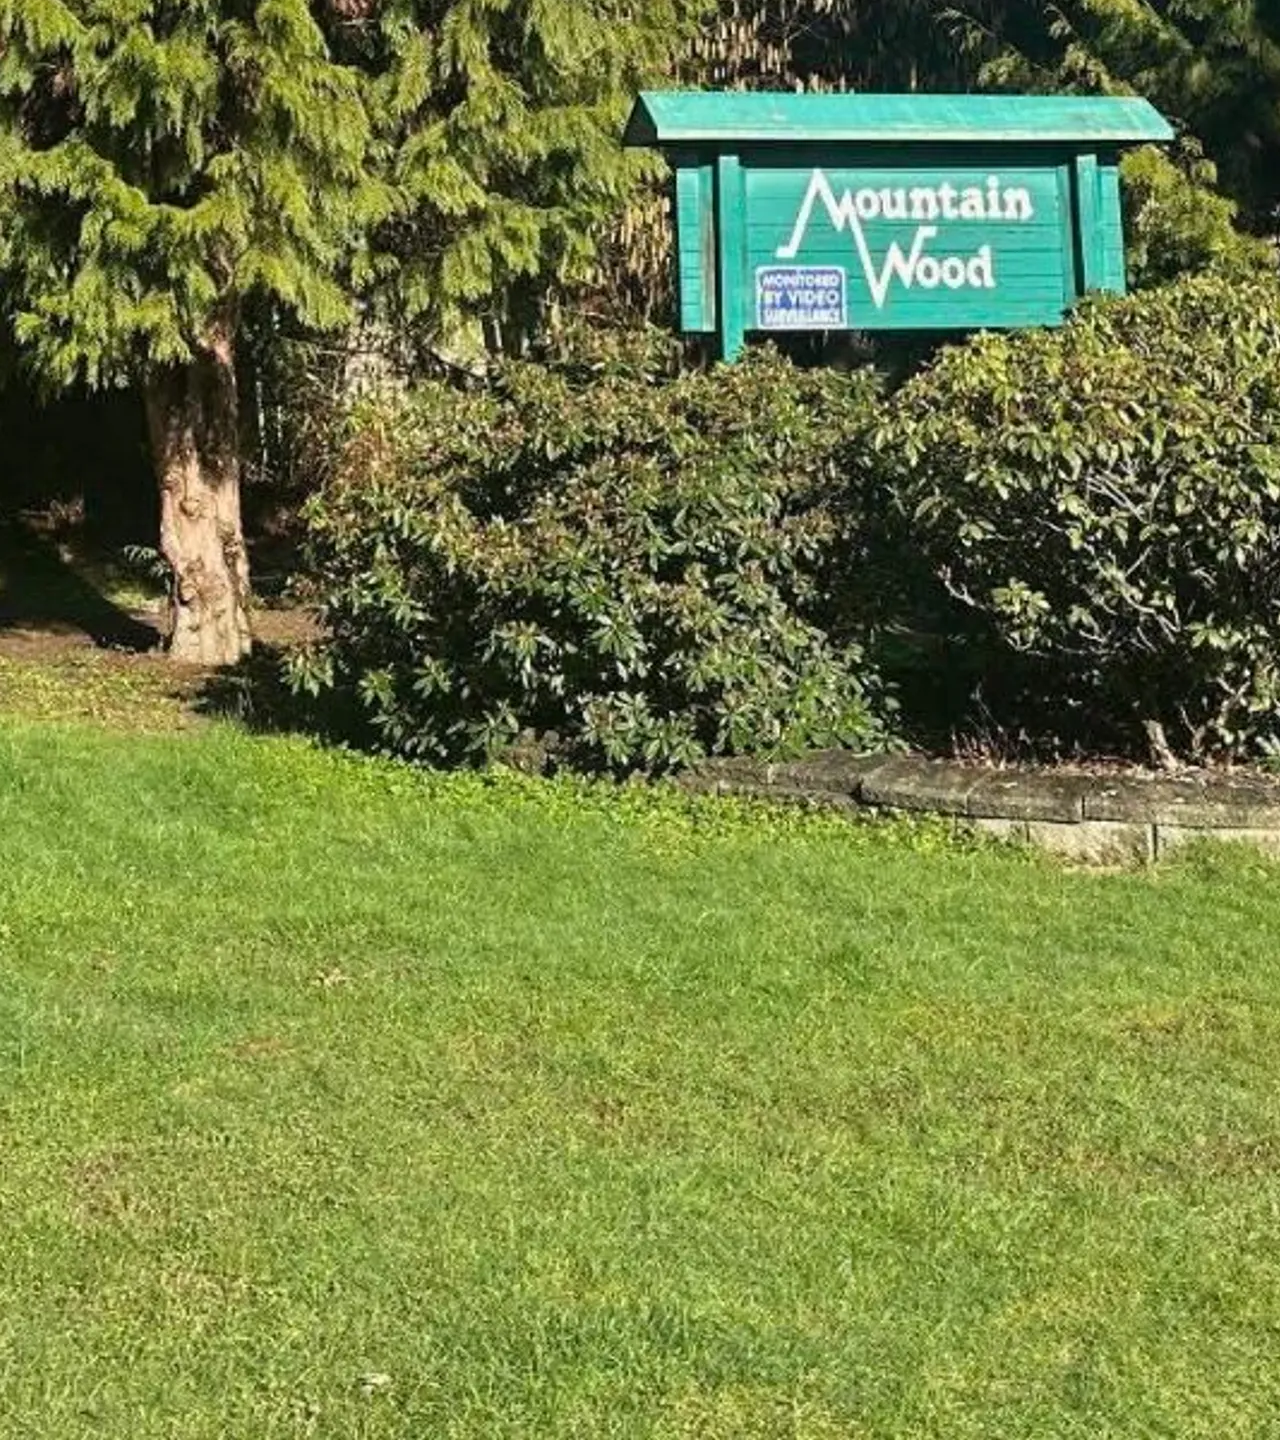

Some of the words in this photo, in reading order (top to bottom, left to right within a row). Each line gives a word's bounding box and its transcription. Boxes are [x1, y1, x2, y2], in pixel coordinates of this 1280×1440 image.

[775, 168, 1034, 258] Mountain
[762, 273, 840, 287] MONITORED
[849, 216, 997, 310] Wood
[785, 289, 839, 304] VIDEO
